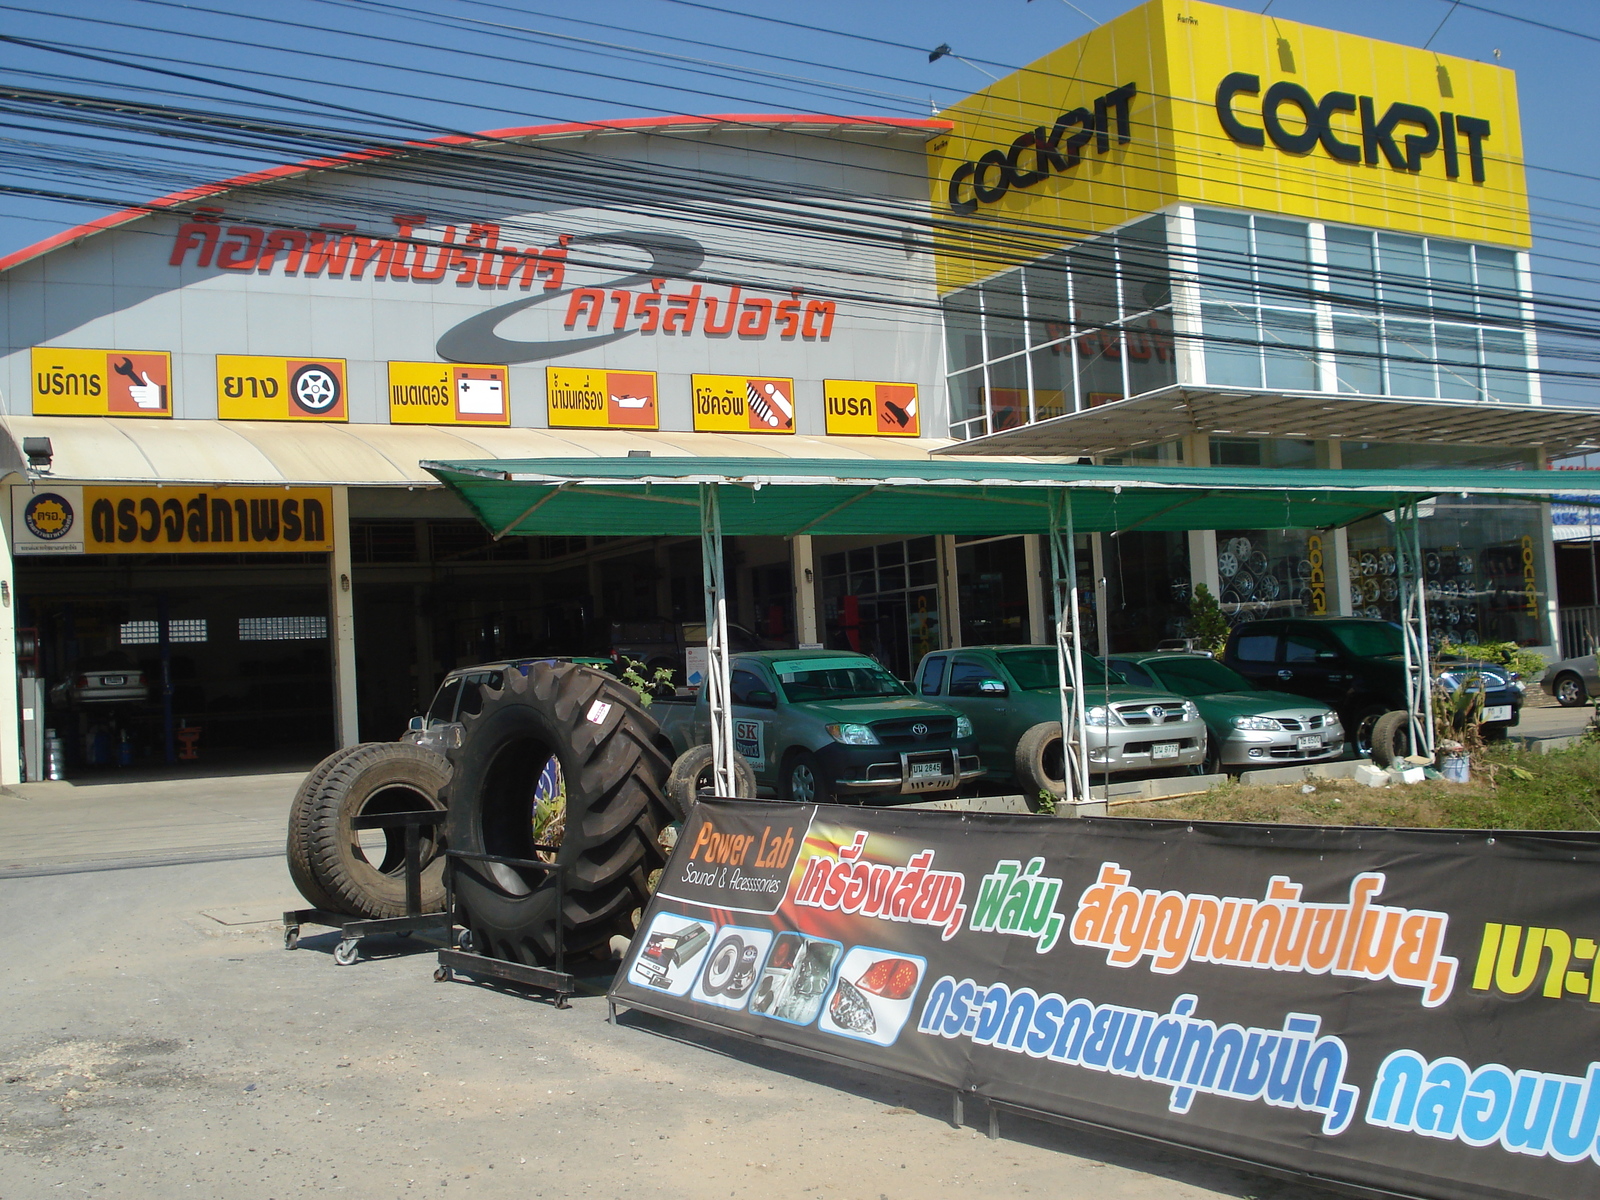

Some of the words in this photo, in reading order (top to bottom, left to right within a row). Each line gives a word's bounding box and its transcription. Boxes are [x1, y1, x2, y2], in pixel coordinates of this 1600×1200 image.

[1216, 71, 1491, 183] COCKPIT
[949, 82, 1137, 216] COCKPIT
[37, 366, 102, 397] บริการ
[223, 376, 279, 398] ยาง
[392, 371, 449, 406] แบตเตอรี่
[551, 373, 604, 411] น้ำมันเครื่อง
[828, 397, 873, 416] เบรค
[37, 511, 62, 521] ตรอ.
[91, 493, 326, 543] ตรวจสภาพรถ
[1308, 535, 1327, 616] COCKPI
[1520, 533, 1539, 620] COCKPIT
[737, 723, 758, 740] SK
[924, 763, 941, 773] 2845
[689, 821, 755, 867] Power
[754, 825, 795, 869] Lab
[681, 862, 719, 887] Sound
[718, 867, 728, 889] &
[794, 831, 967, 940] เครื่องเสียง,
[969, 857, 1065, 953] ฟิล์ม,
[1472, 922, 1600, 1004] เบาะ
[918, 975, 1360, 1136] กระจกรถยนต์ทุกชนิด,
[1366, 1048, 1600, 1164] กลอนป
